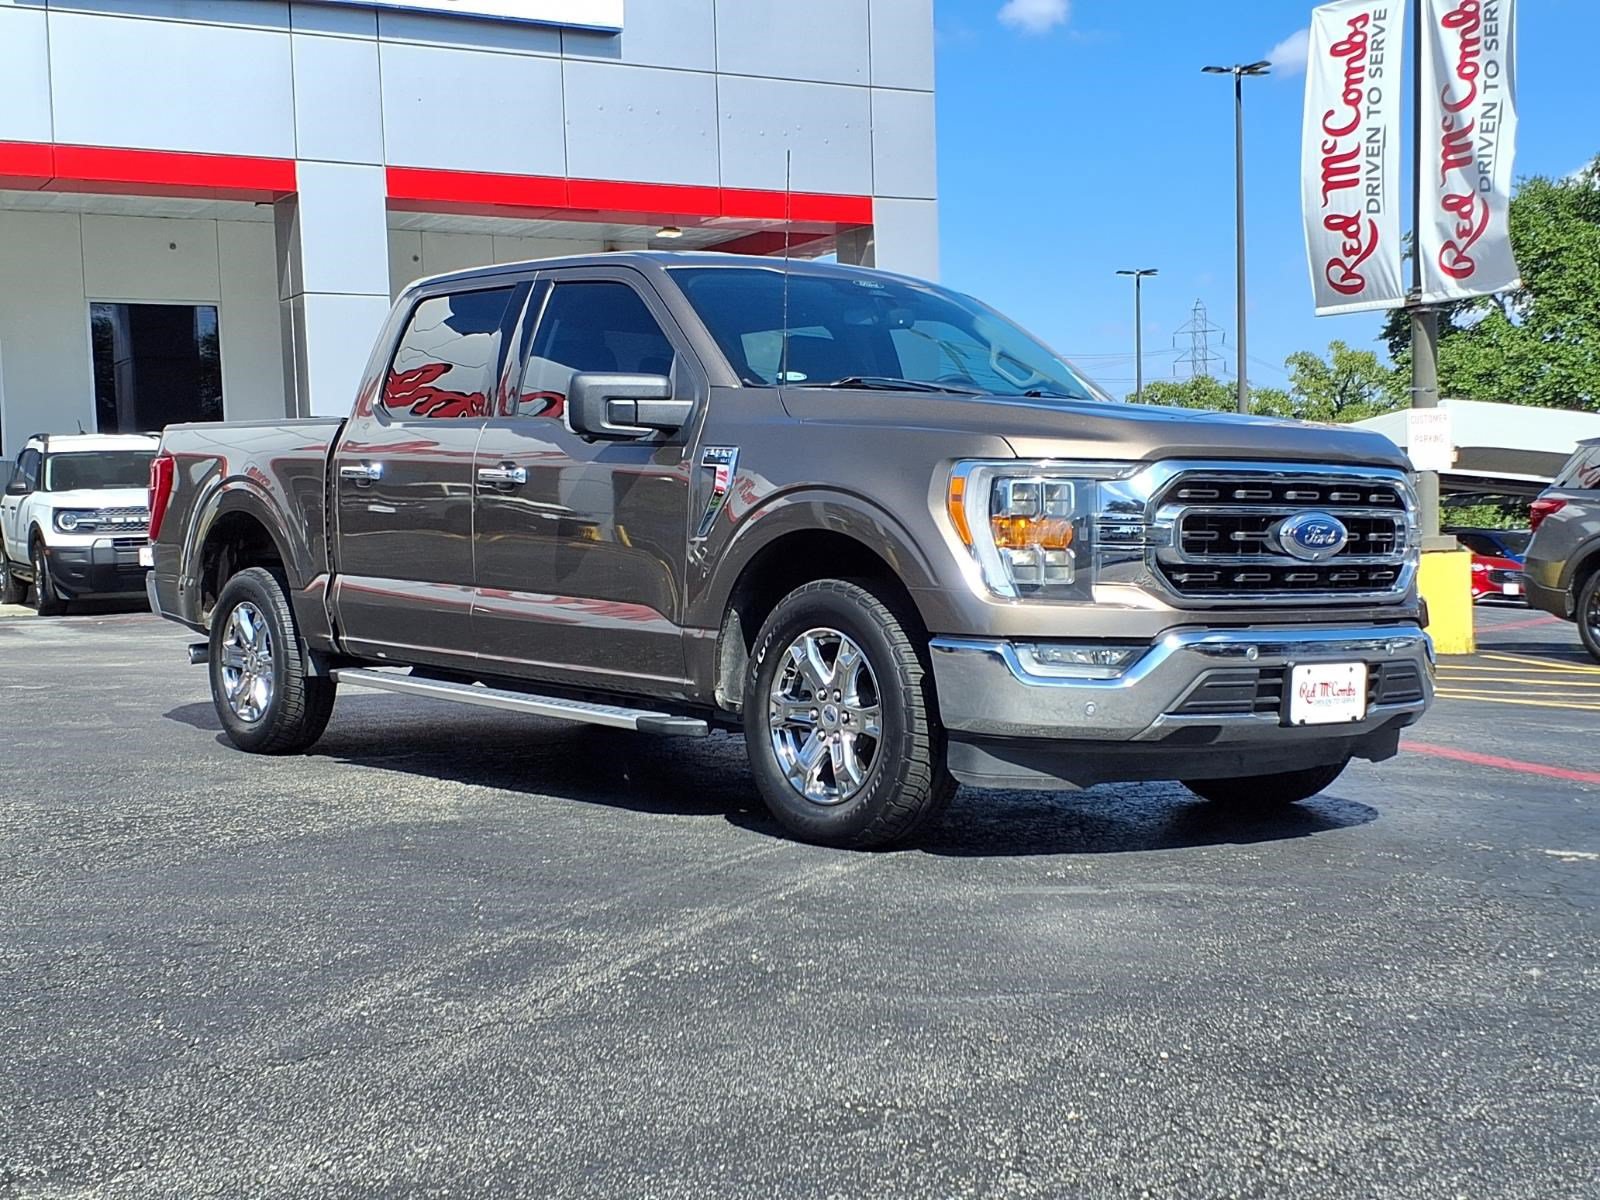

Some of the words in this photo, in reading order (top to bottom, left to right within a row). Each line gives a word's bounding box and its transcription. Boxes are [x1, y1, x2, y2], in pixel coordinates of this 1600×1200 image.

[1368, 8, 1388, 79] SERVE
[1484, 60, 1499, 94] TO
[1366, 86, 1383, 119] TO
[1364, 126, 1382, 214] DRIVEN
[1478, 101, 1498, 193] DRIVEN
[1325, 211, 1379, 294] Red
[1438, 189, 1490, 280] Red
[1304, 524, 1336, 545] Ford
[1300, 682, 1316, 704] Red
